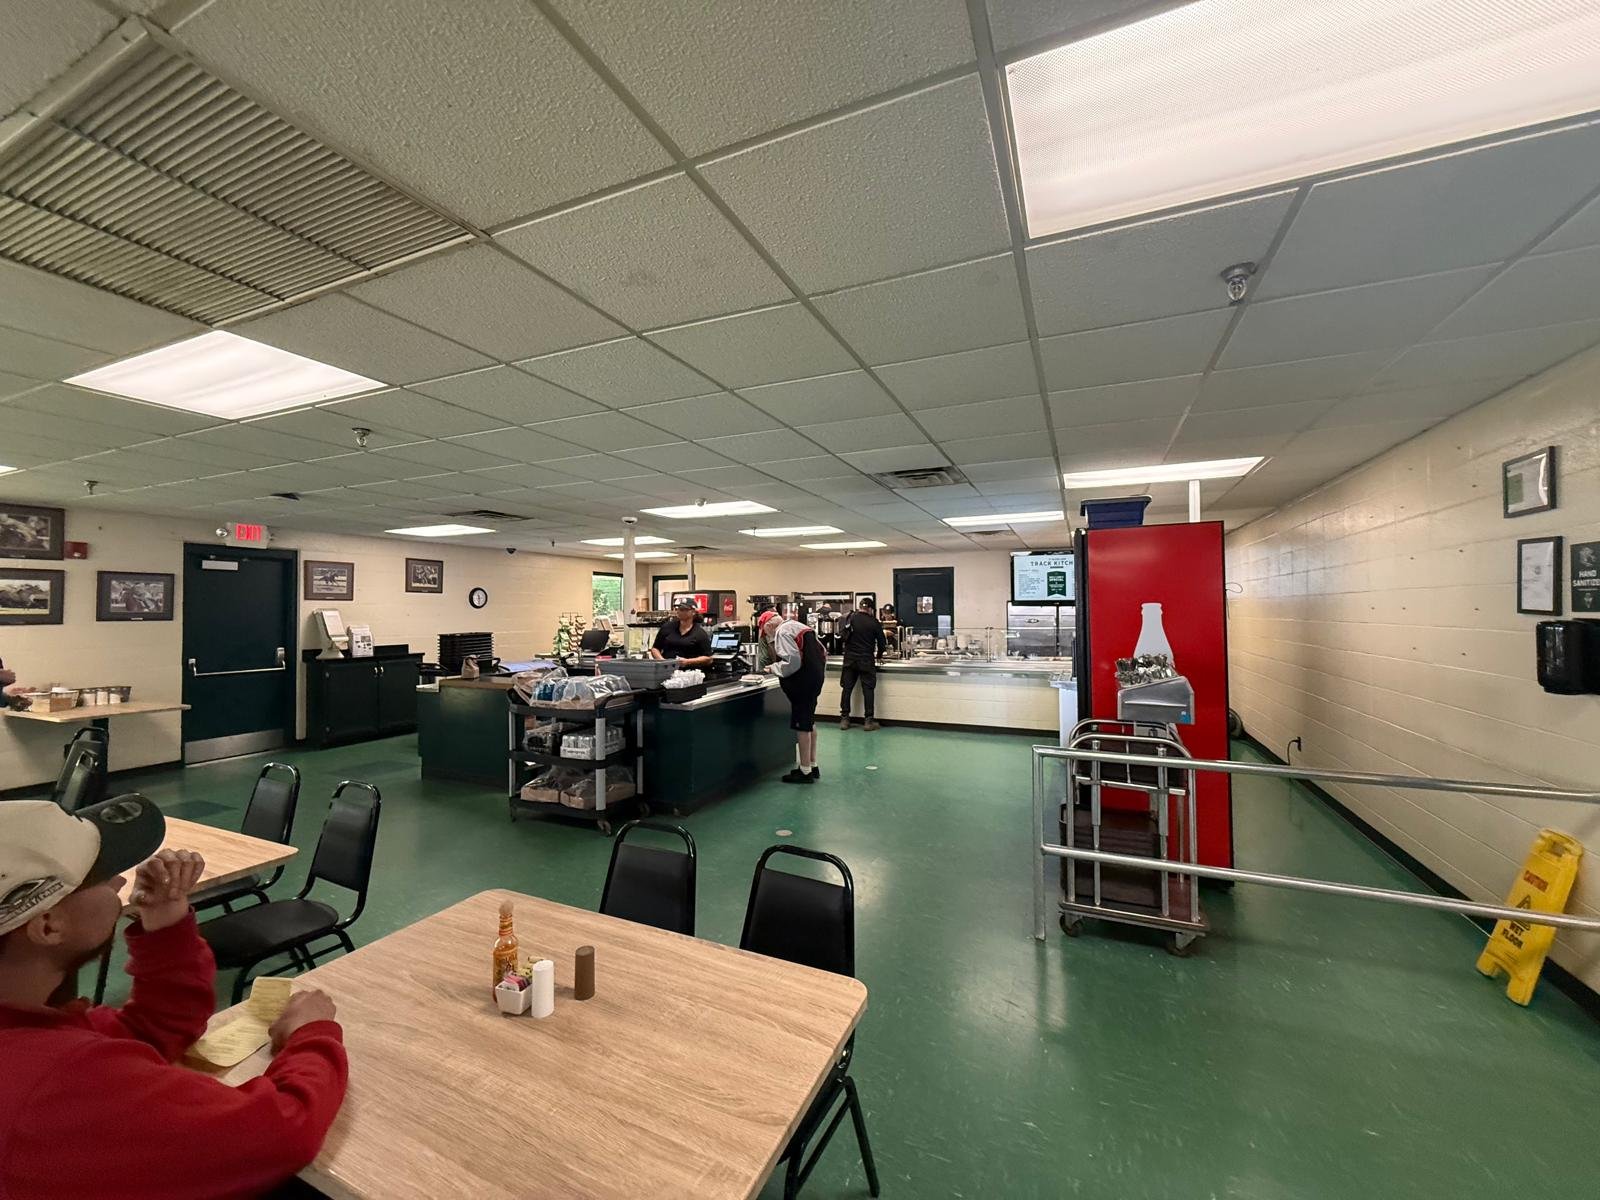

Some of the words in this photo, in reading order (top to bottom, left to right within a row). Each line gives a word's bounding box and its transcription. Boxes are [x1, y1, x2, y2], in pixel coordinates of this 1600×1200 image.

[236, 524, 261, 542] EXIT
[1579, 570, 1597, 578] HAND
[1573, 579, 1600, 587] SANITIZE
[1509, 921, 1524, 936] WET
[1502, 928, 1524, 949] FLOOR
